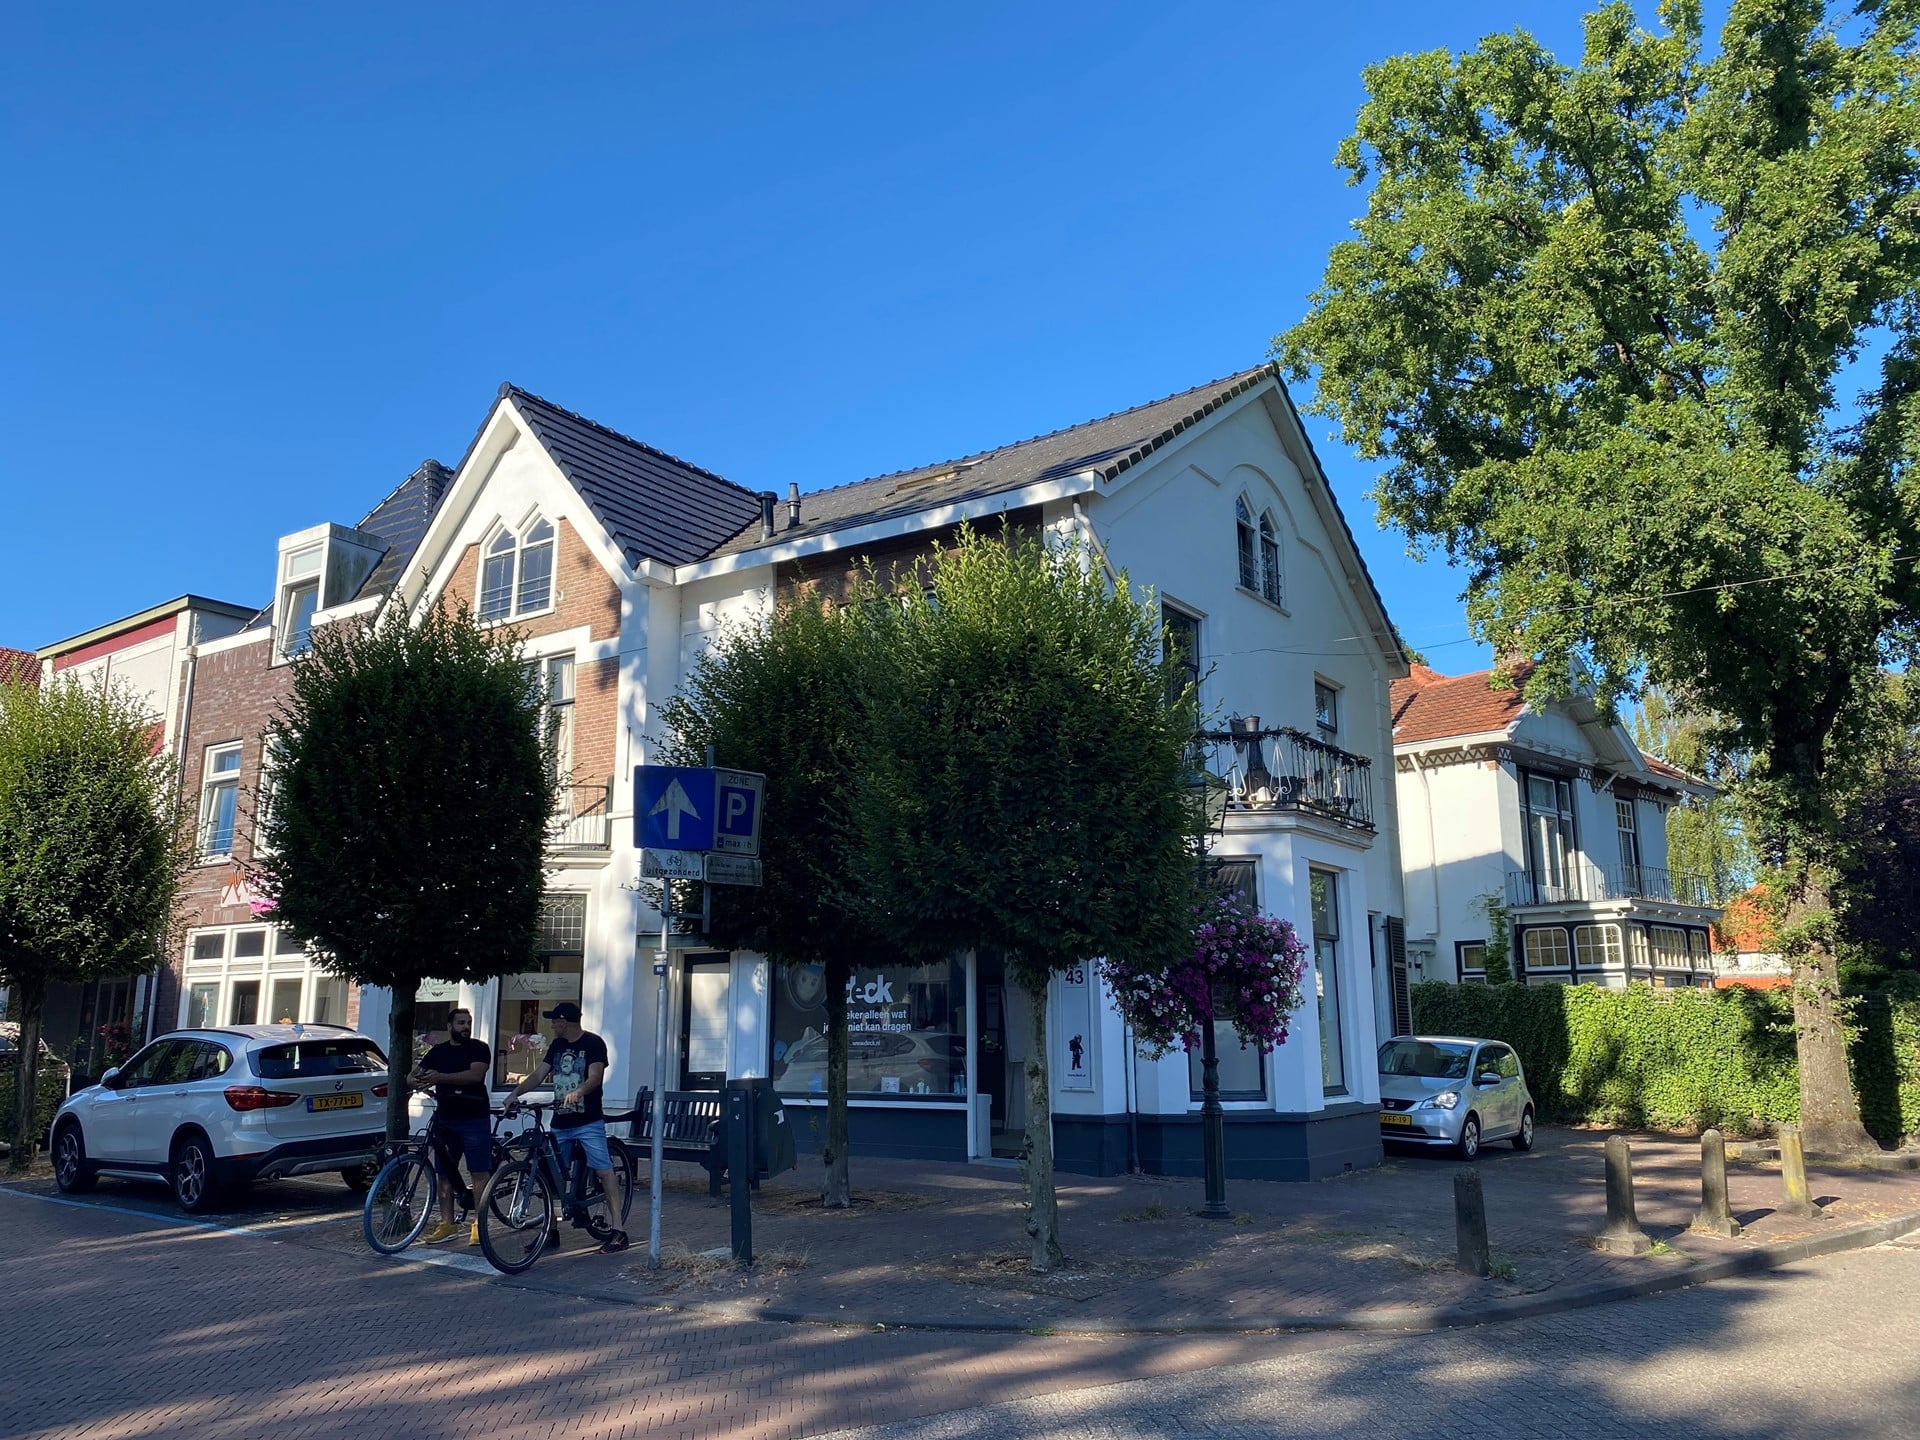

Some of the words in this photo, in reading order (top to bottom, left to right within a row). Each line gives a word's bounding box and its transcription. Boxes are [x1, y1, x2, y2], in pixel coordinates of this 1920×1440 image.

[728, 775, 750, 786] ZONE
[726, 791, 747, 829] P
[646, 866, 700, 877] uitgezonderd
[1065, 969, 1084, 985] 43
[864, 1009, 890, 1020] alleen
[891, 1010, 907, 1020] wat
[847, 1022, 864, 1031] niet
[865, 1022, 881, 1031] kan
[882, 1022, 912, 1033] dragen
[318, 1095, 357, 1108] TX-771-D
